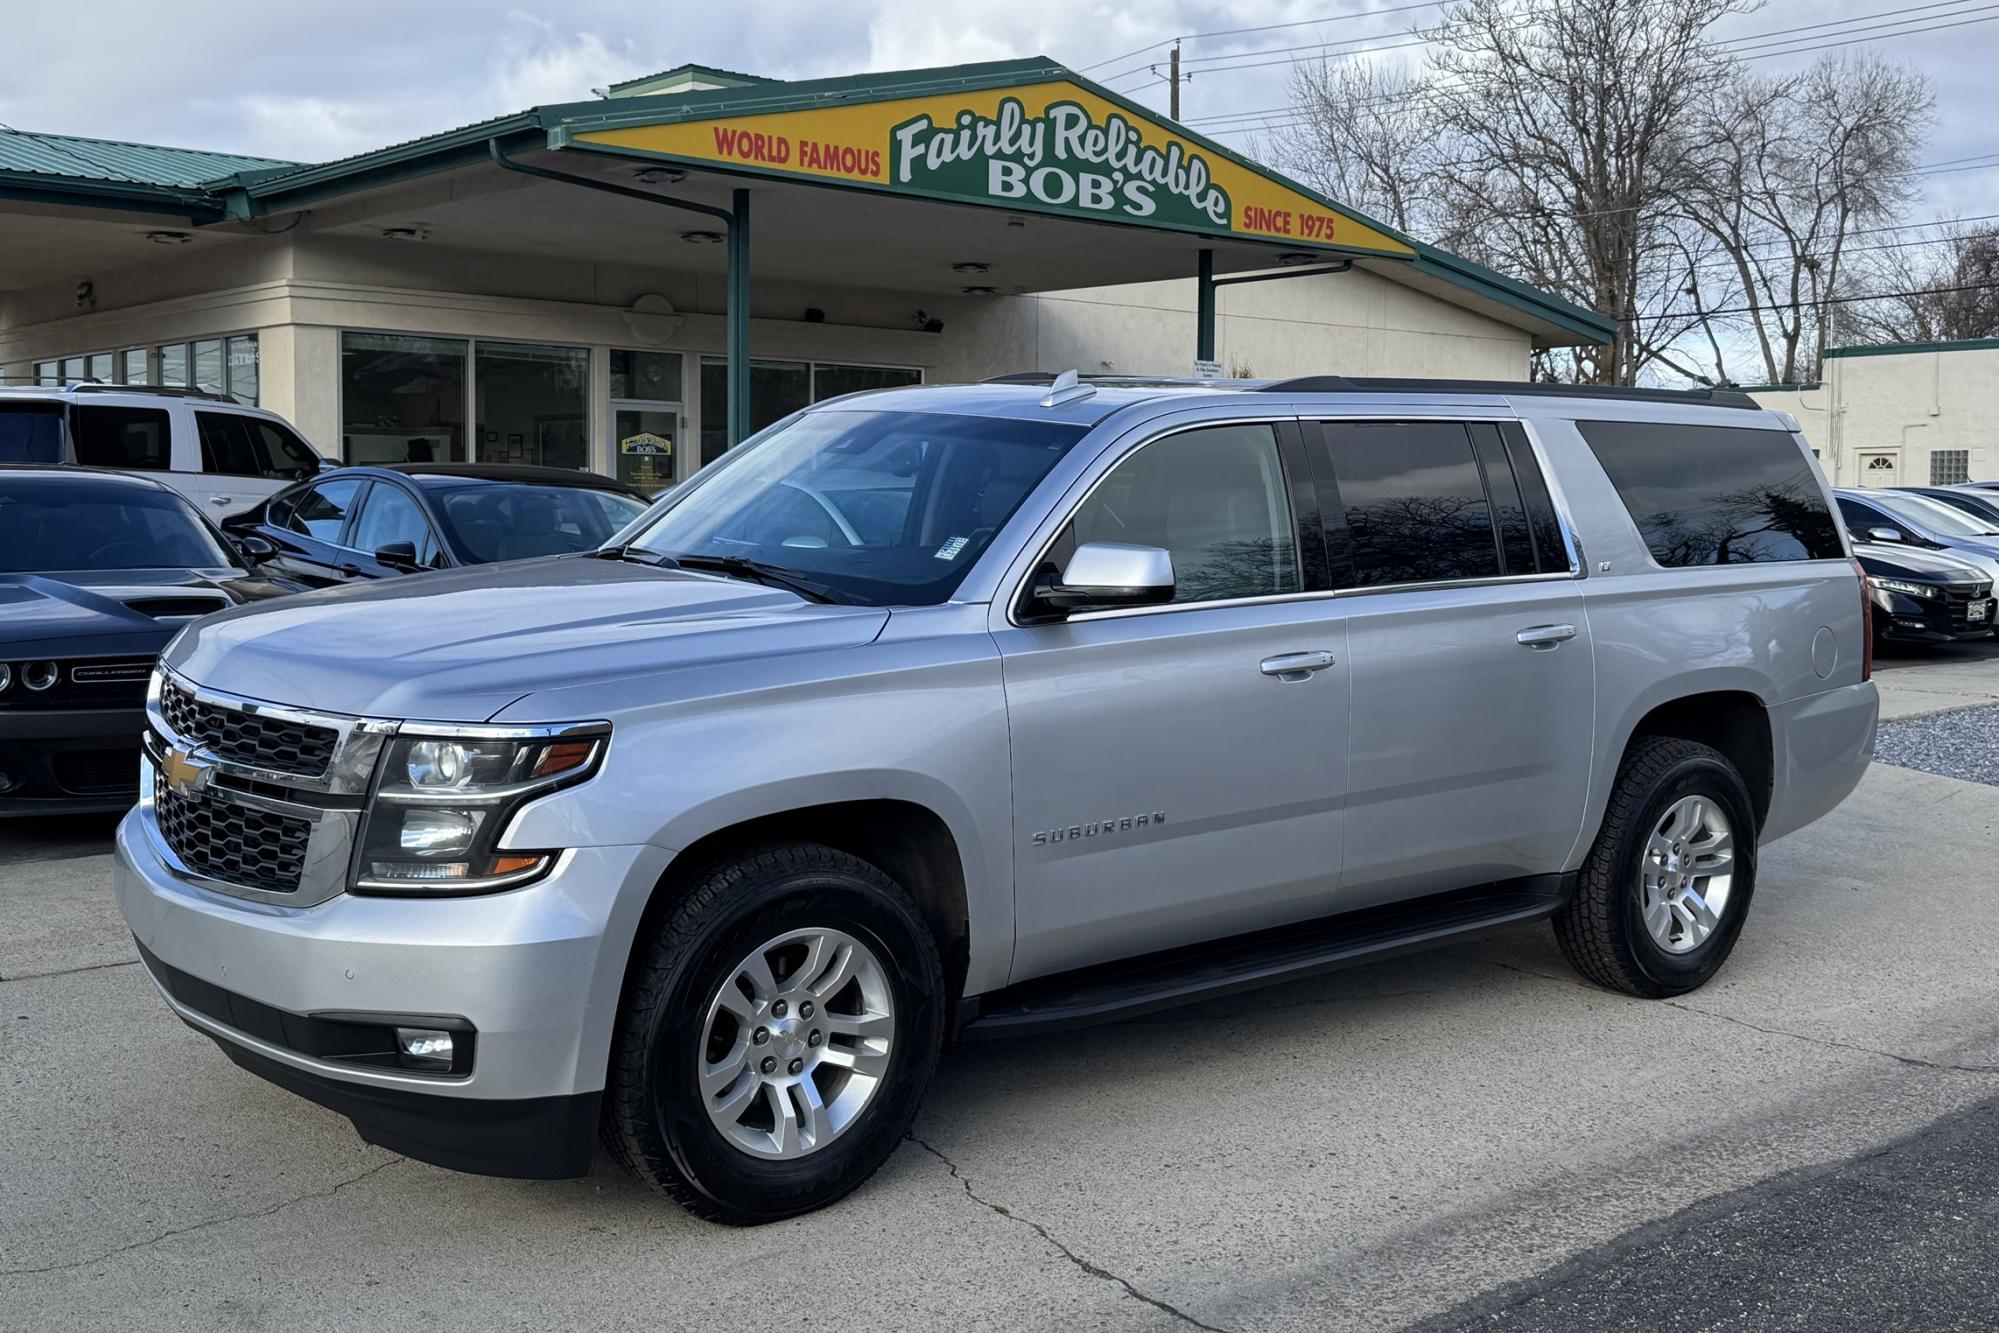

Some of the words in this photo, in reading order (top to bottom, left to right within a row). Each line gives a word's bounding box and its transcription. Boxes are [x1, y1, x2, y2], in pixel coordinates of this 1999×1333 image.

[713, 126, 790, 165] WORLD
[799, 140, 881, 178] FAMOUS
[896, 101, 1045, 182] Fairly
[1050, 105, 1228, 225] Reliable
[988, 159, 1157, 218] BOB'S
[1243, 206, 1291, 234] SINCE
[1299, 213, 1335, 240] 1975
[1032, 810, 1166, 847] SUBURBAN
